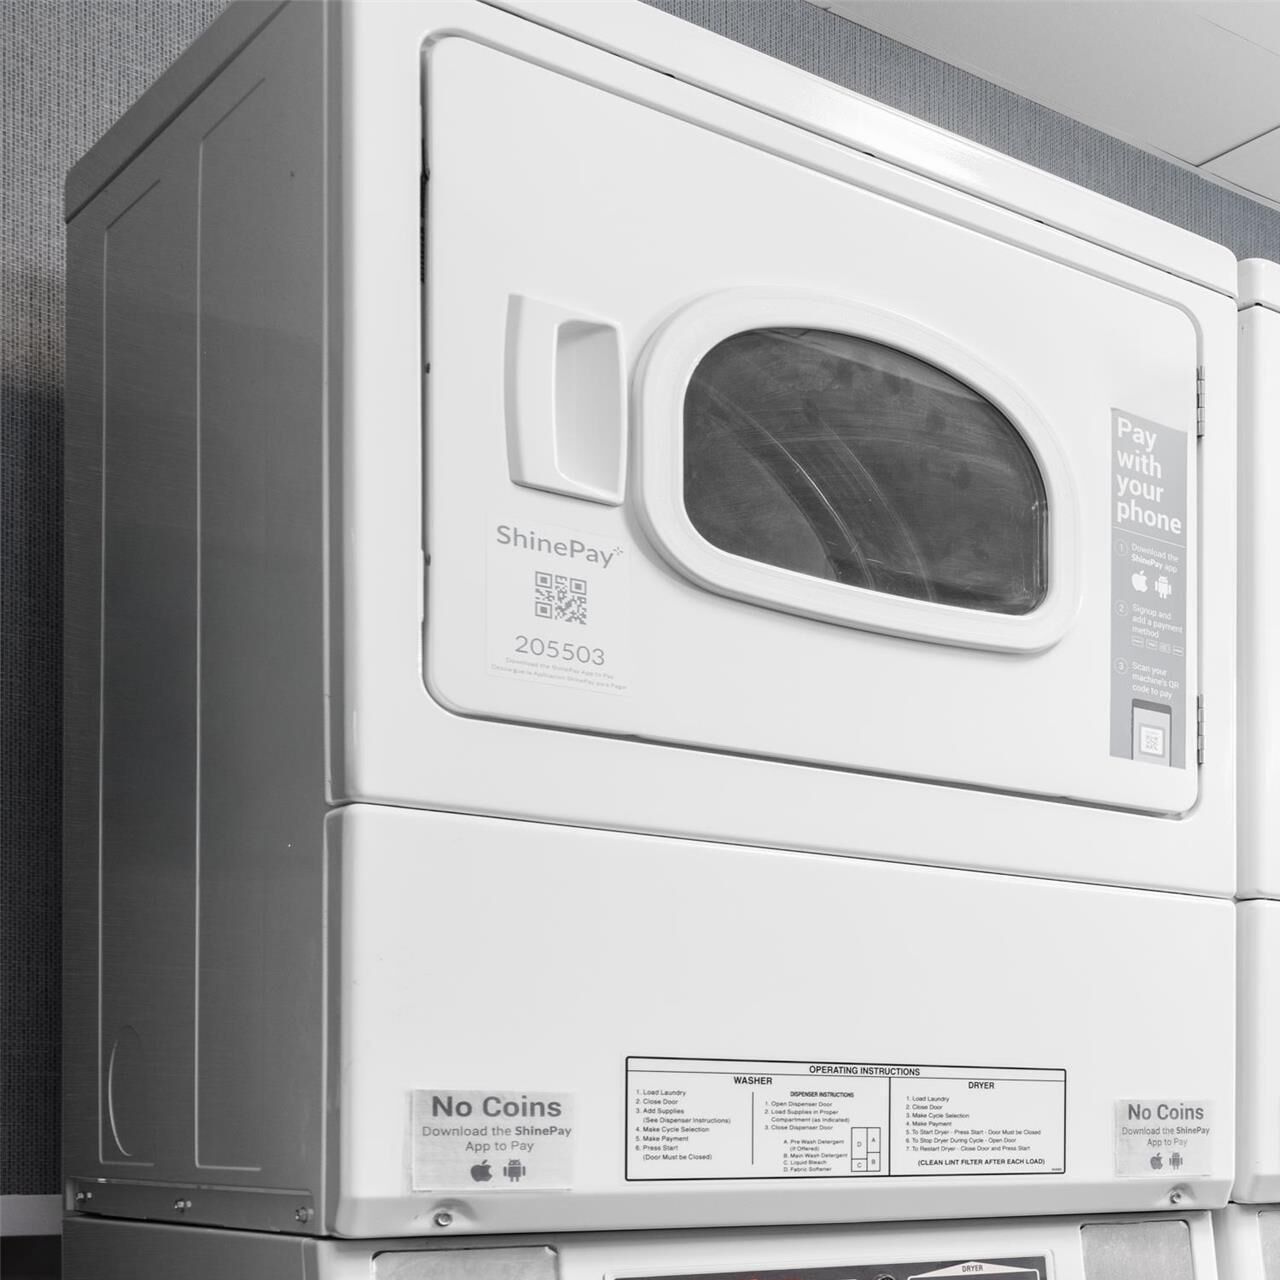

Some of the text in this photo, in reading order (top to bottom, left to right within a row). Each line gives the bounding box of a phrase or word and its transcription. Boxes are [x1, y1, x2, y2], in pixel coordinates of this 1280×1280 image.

[1118, 416, 1157, 452] Pay
[1117, 450, 1161, 478] with
[1117, 474, 1164, 502] your
[1117, 499, 1181, 534] phone
[496, 525, 613, 568] ShinePay
[1131, 543, 1166, 559] Download
[1167, 552, 1178, 562] the
[1131, 554, 1178, 574] ShinePay app
[1132, 603, 1157, 618] Signup
[1159, 610, 1171, 620] and
[515, 635, 605, 665] 205503
[1132, 660, 1149, 674] Scan
[809, 1065, 920, 1077] OPERATING INSTRUCTIONS
[733, 1076, 773, 1085] WASHER
[968, 1081, 995, 1089] DRYER
[432, 1095, 562, 1117] No Coins
[1128, 1103, 1204, 1120] No Coins
[422, 1126, 572, 1138] Download the ShinePay
[1121, 1126, 1210, 1136] Download the ShinePay
[465, 1140, 535, 1153] App to Pay
[1147, 1138, 1162, 1147] App
[1173, 1137, 1187, 1147] Pay
[961, 1264, 984, 1273] DRYER
